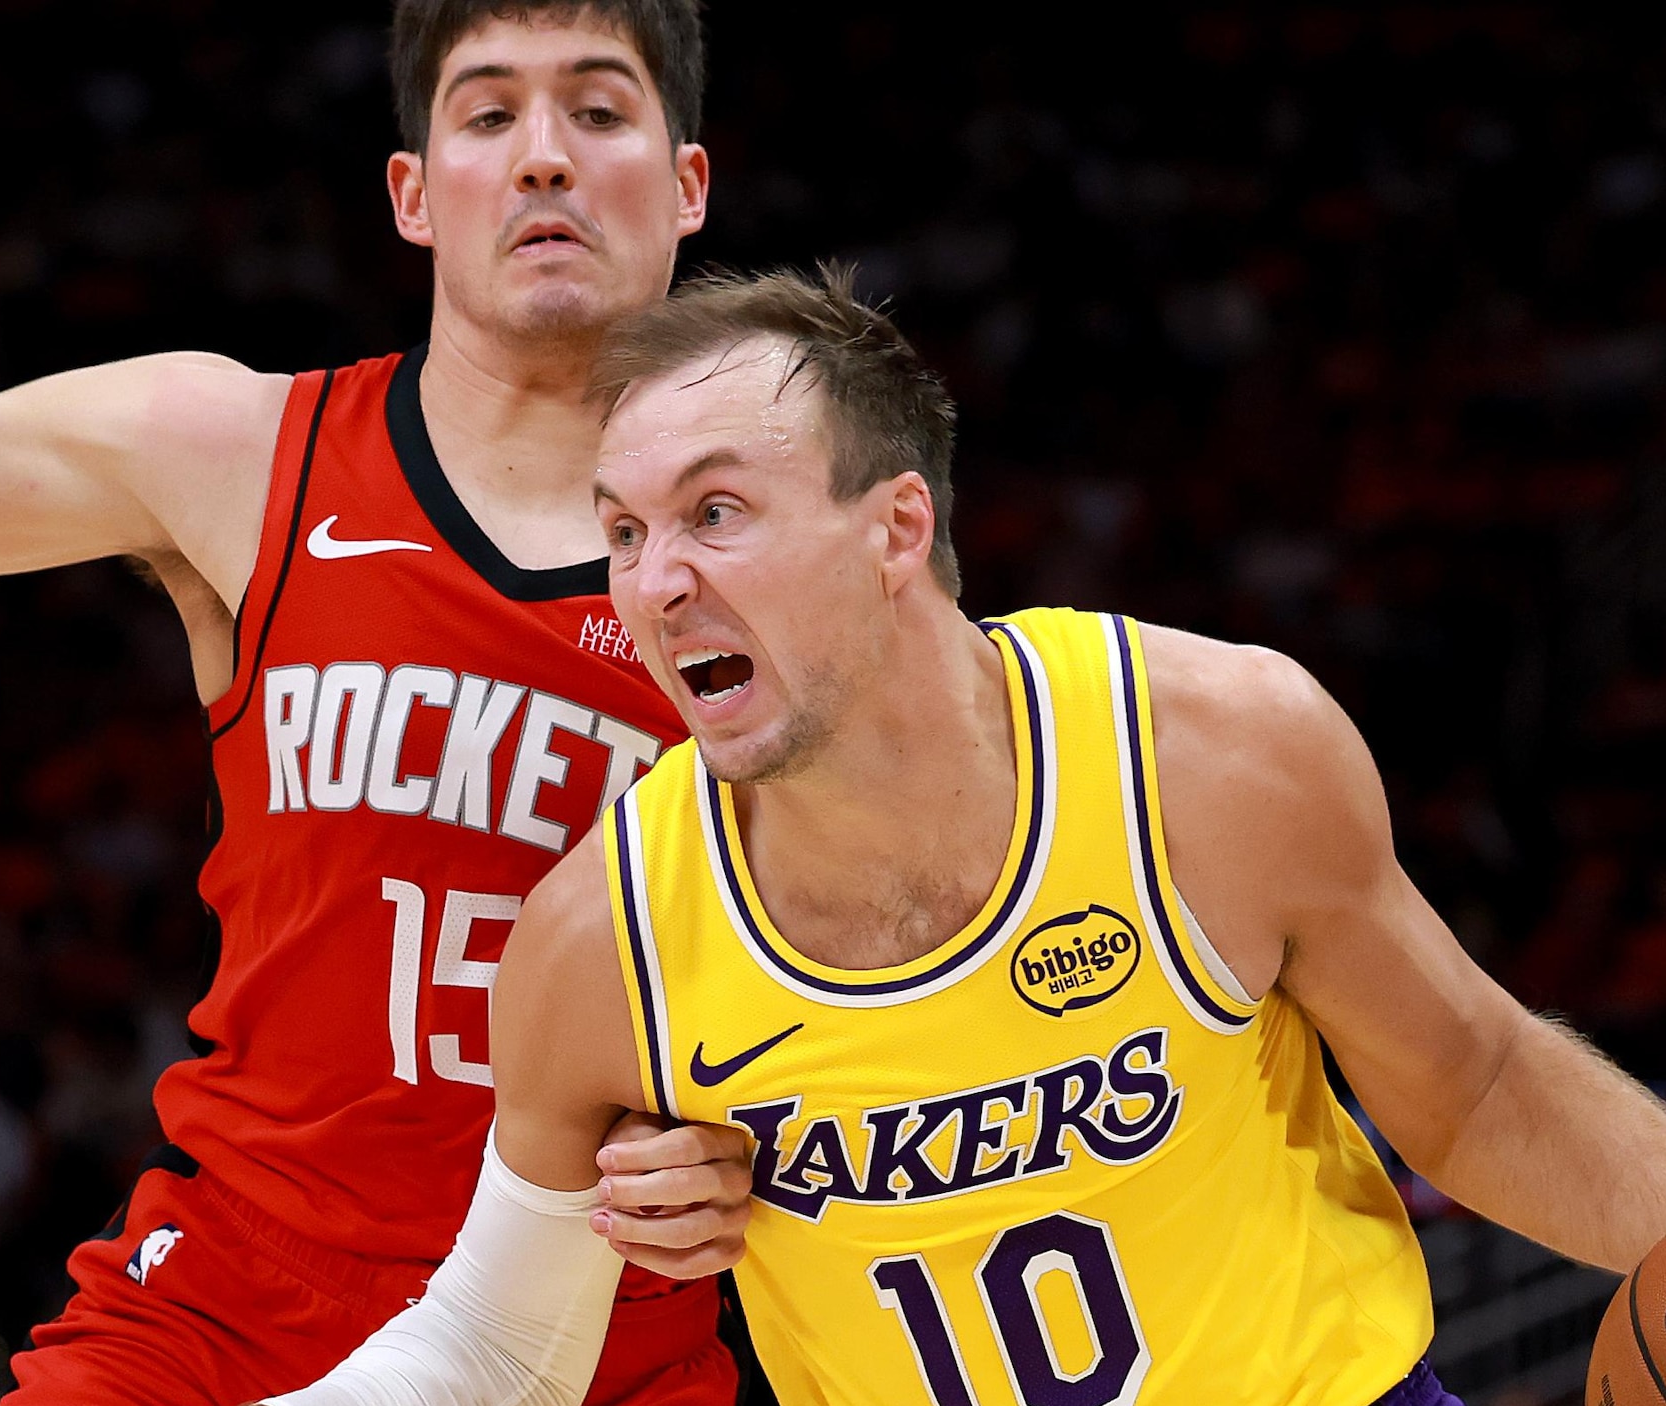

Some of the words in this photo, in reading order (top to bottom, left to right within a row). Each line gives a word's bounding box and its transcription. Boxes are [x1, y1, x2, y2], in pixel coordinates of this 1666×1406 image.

[263, 660, 671, 855] ROCKET
[381, 876, 523, 1088] 15
[1019, 931, 1131, 986] bibigo
[1048, 968, 1096, 994] 비비고
[727, 1027, 1186, 1224] LAKERS
